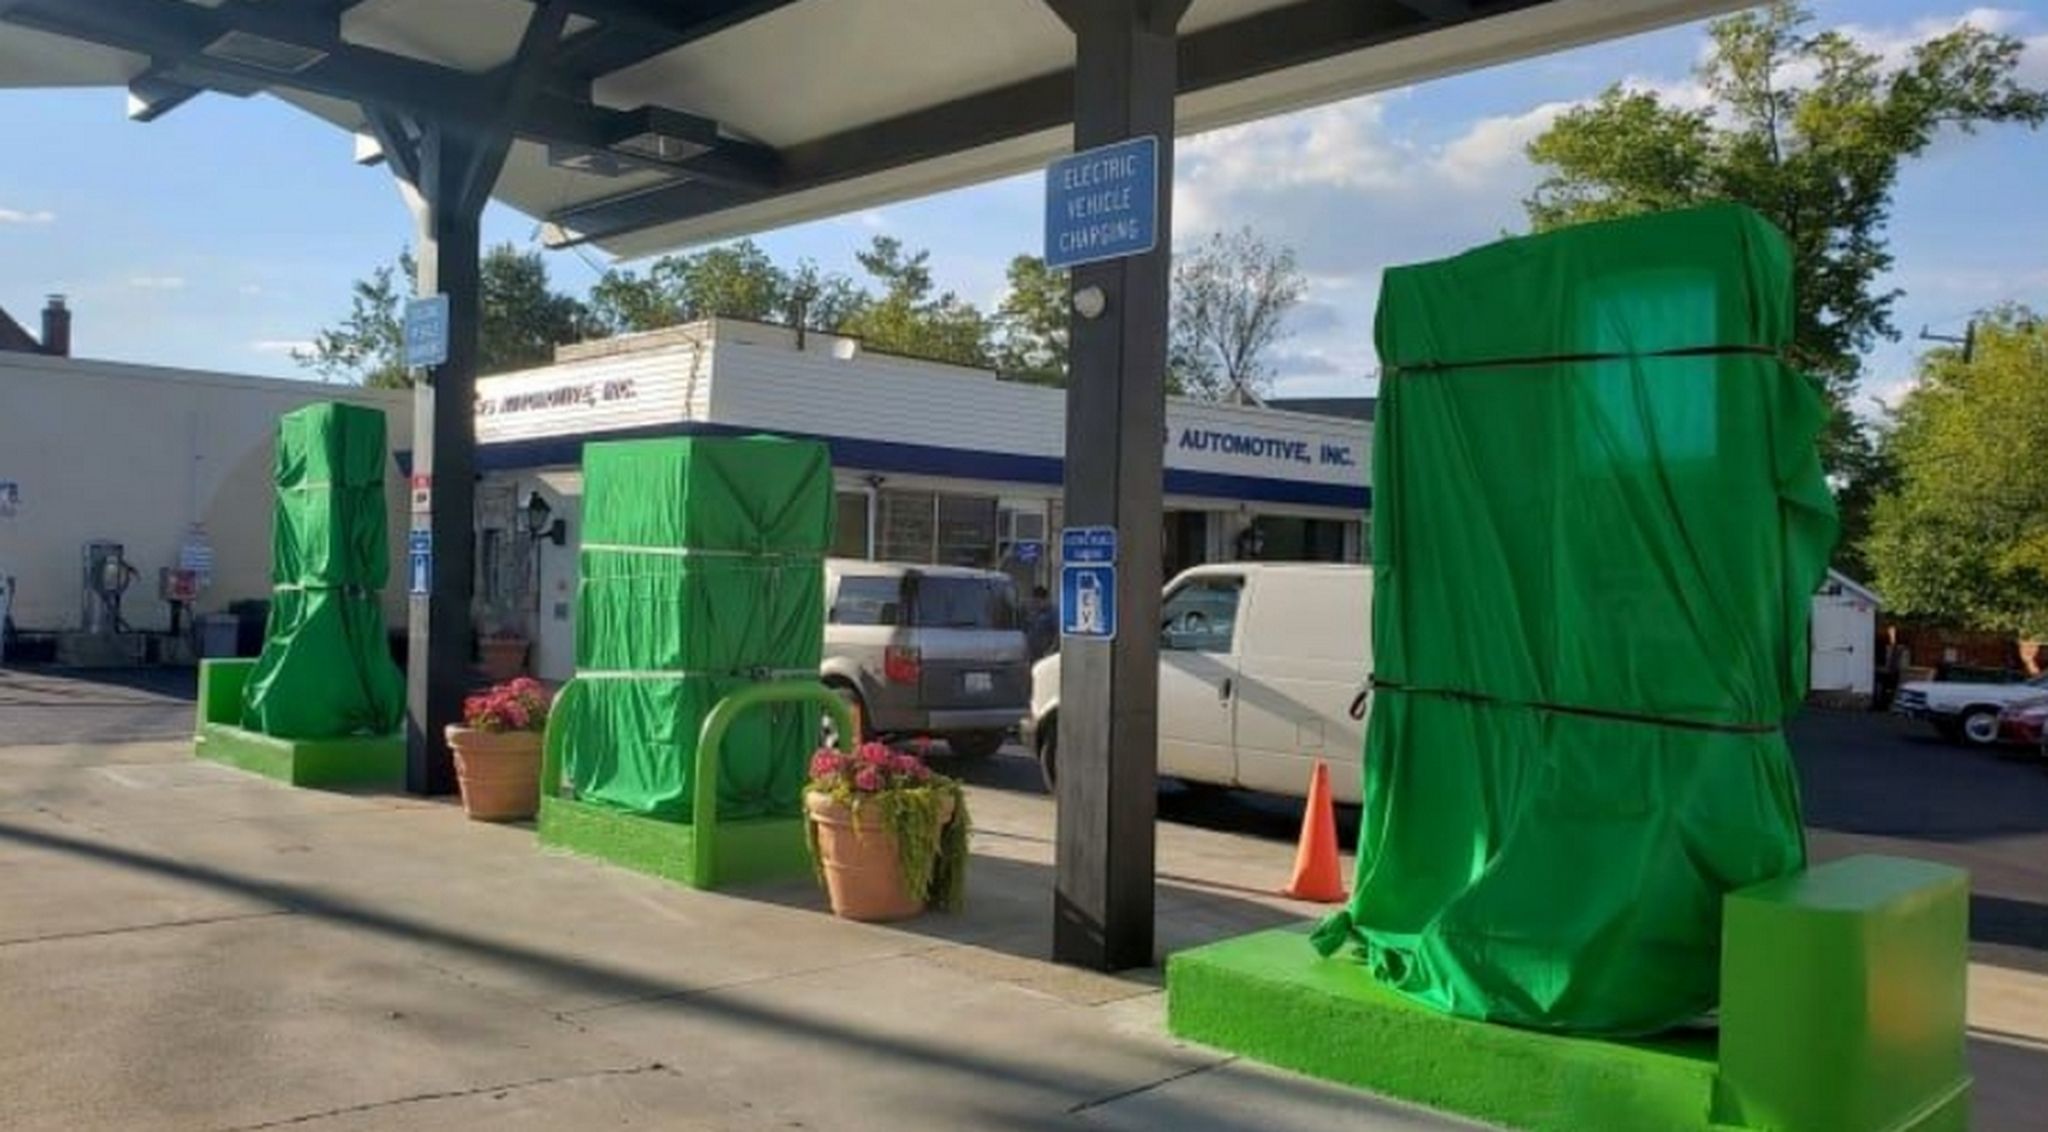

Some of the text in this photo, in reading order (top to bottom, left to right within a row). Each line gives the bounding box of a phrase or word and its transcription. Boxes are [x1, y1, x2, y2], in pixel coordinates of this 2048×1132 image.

[1063, 154, 1137, 190] ELECTRIC
[1066, 186, 1132, 220] VEHICLE
[1060, 219, 1138, 253] CHARGING
[1179, 429, 1312, 464] AUTOMOTIVE,
[1320, 444, 1356, 467] INC.
